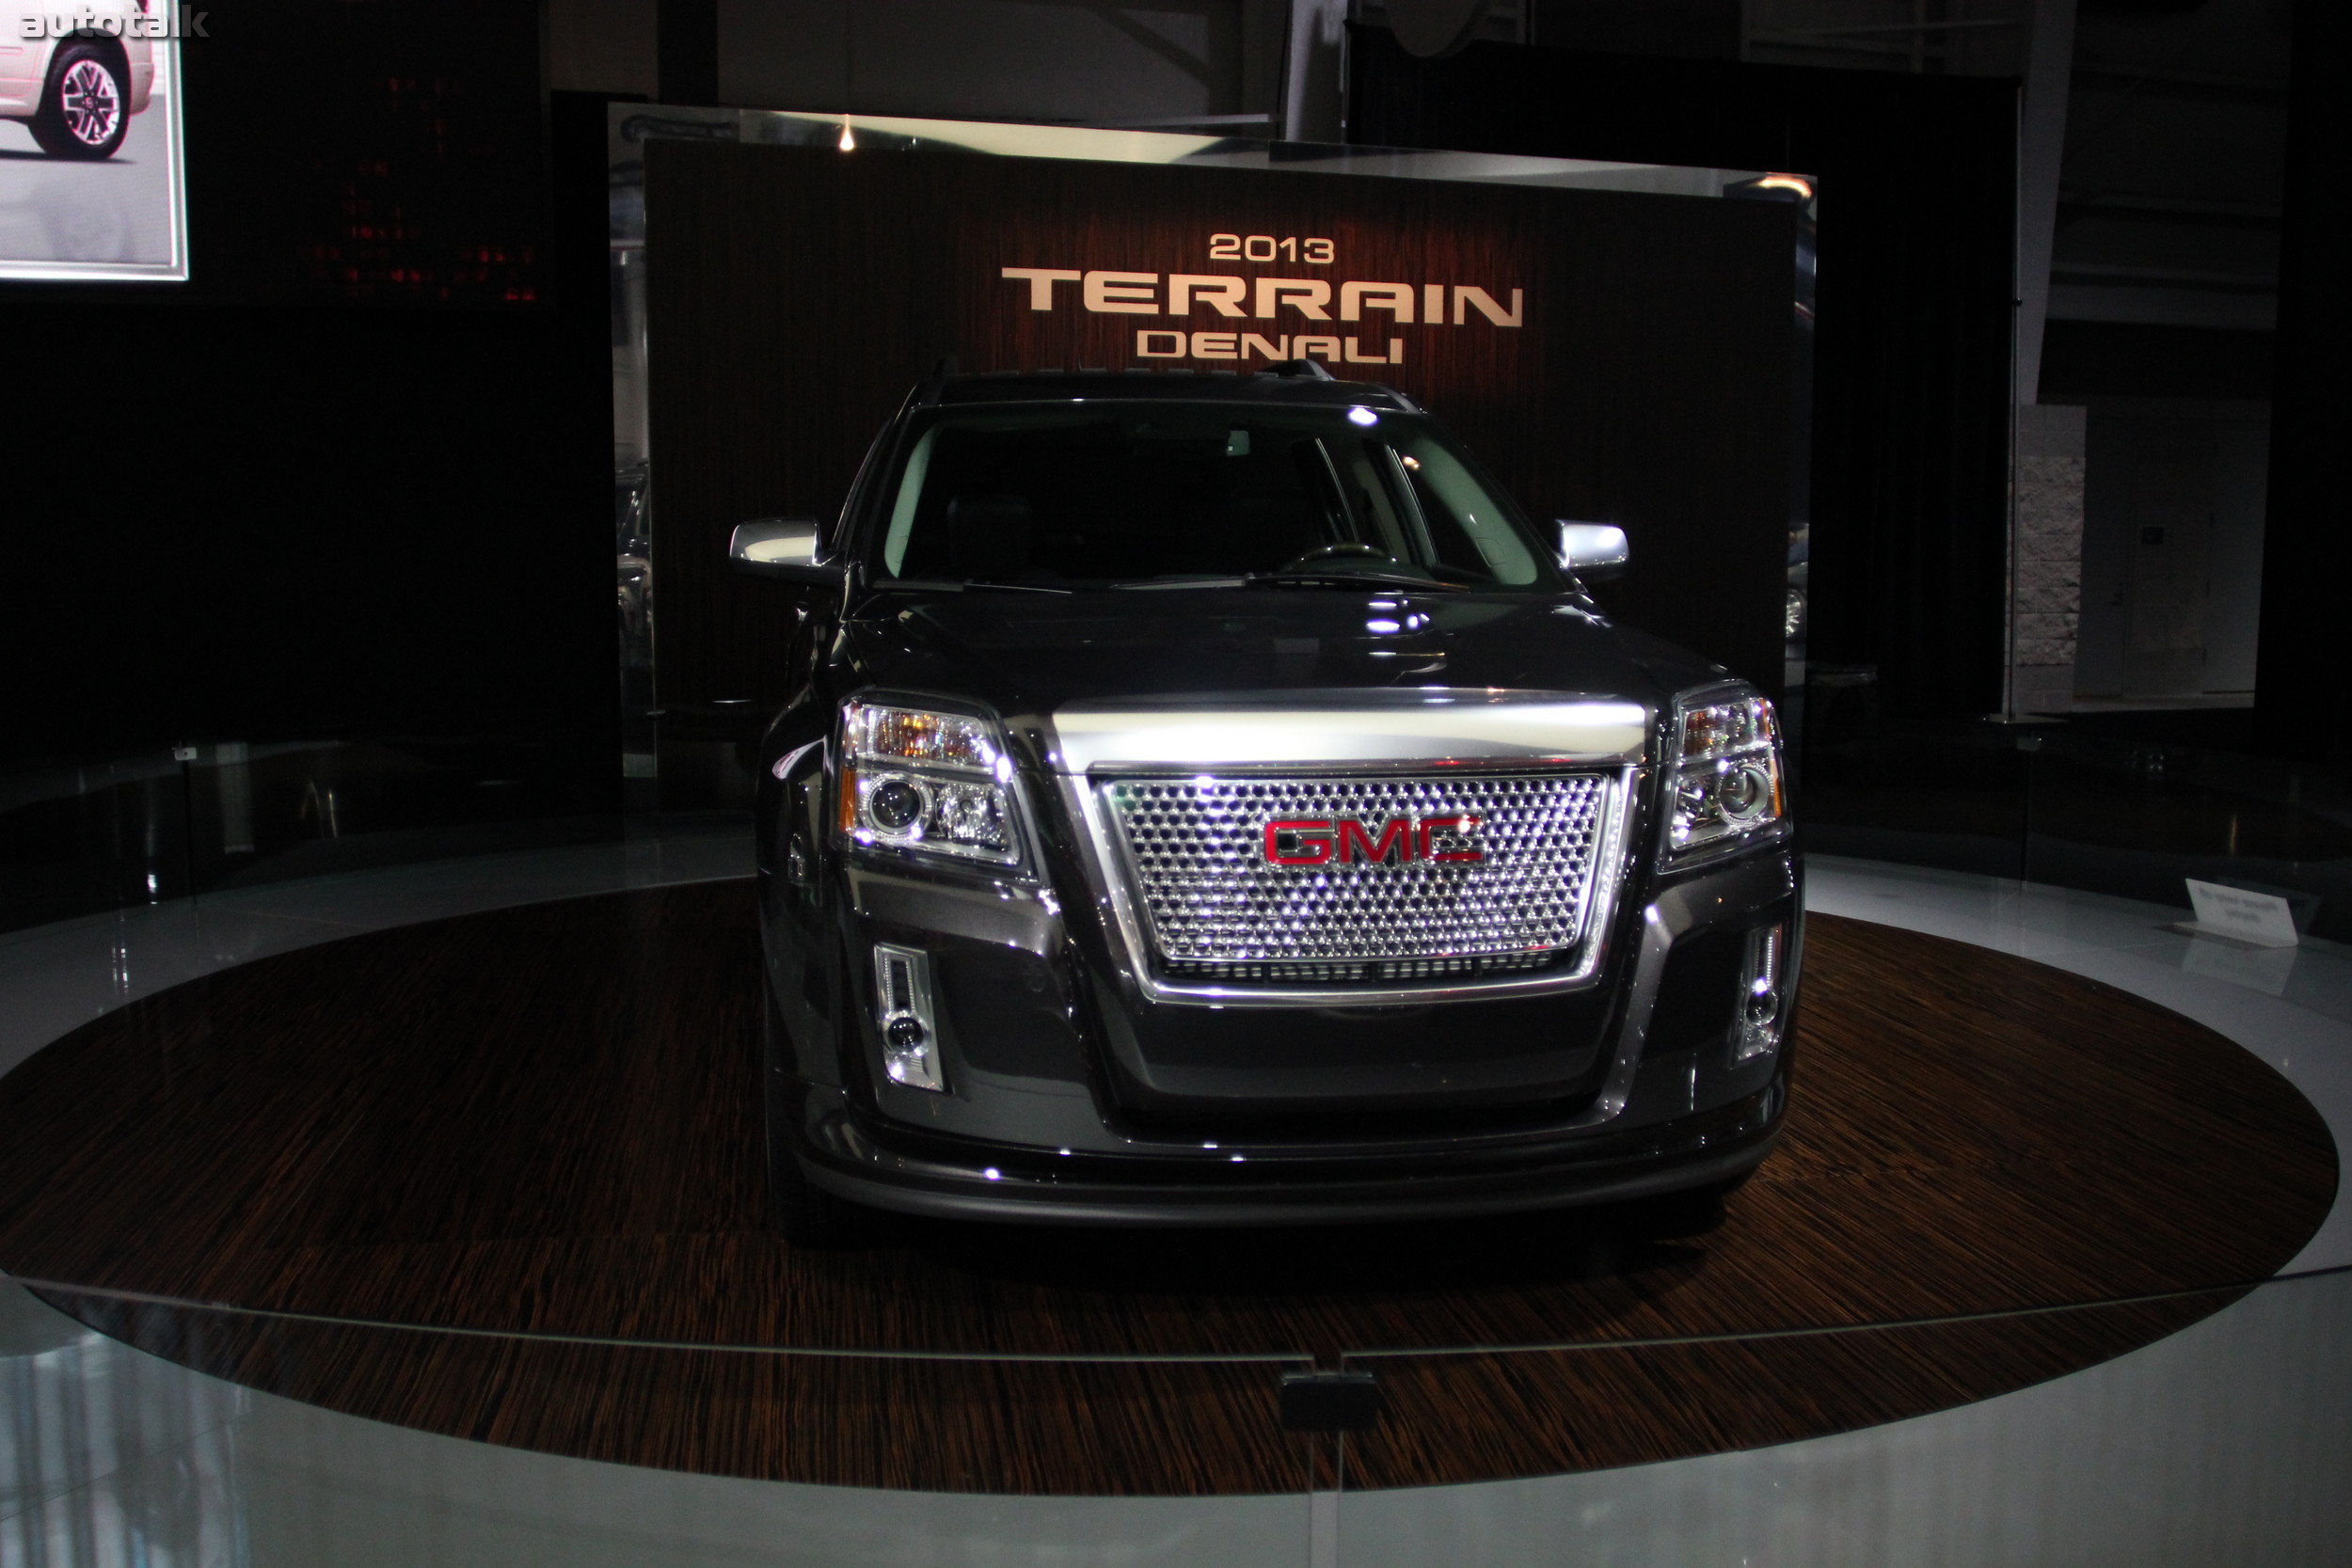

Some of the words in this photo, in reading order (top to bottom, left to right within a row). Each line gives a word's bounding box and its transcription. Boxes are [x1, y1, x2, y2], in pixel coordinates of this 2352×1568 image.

[1209, 233, 1335, 264] 2013
[1001, 267, 1523, 327] TERRAIN
[1136, 330, 1403, 364] DENALI
[1263, 816, 1486, 866] GMC
